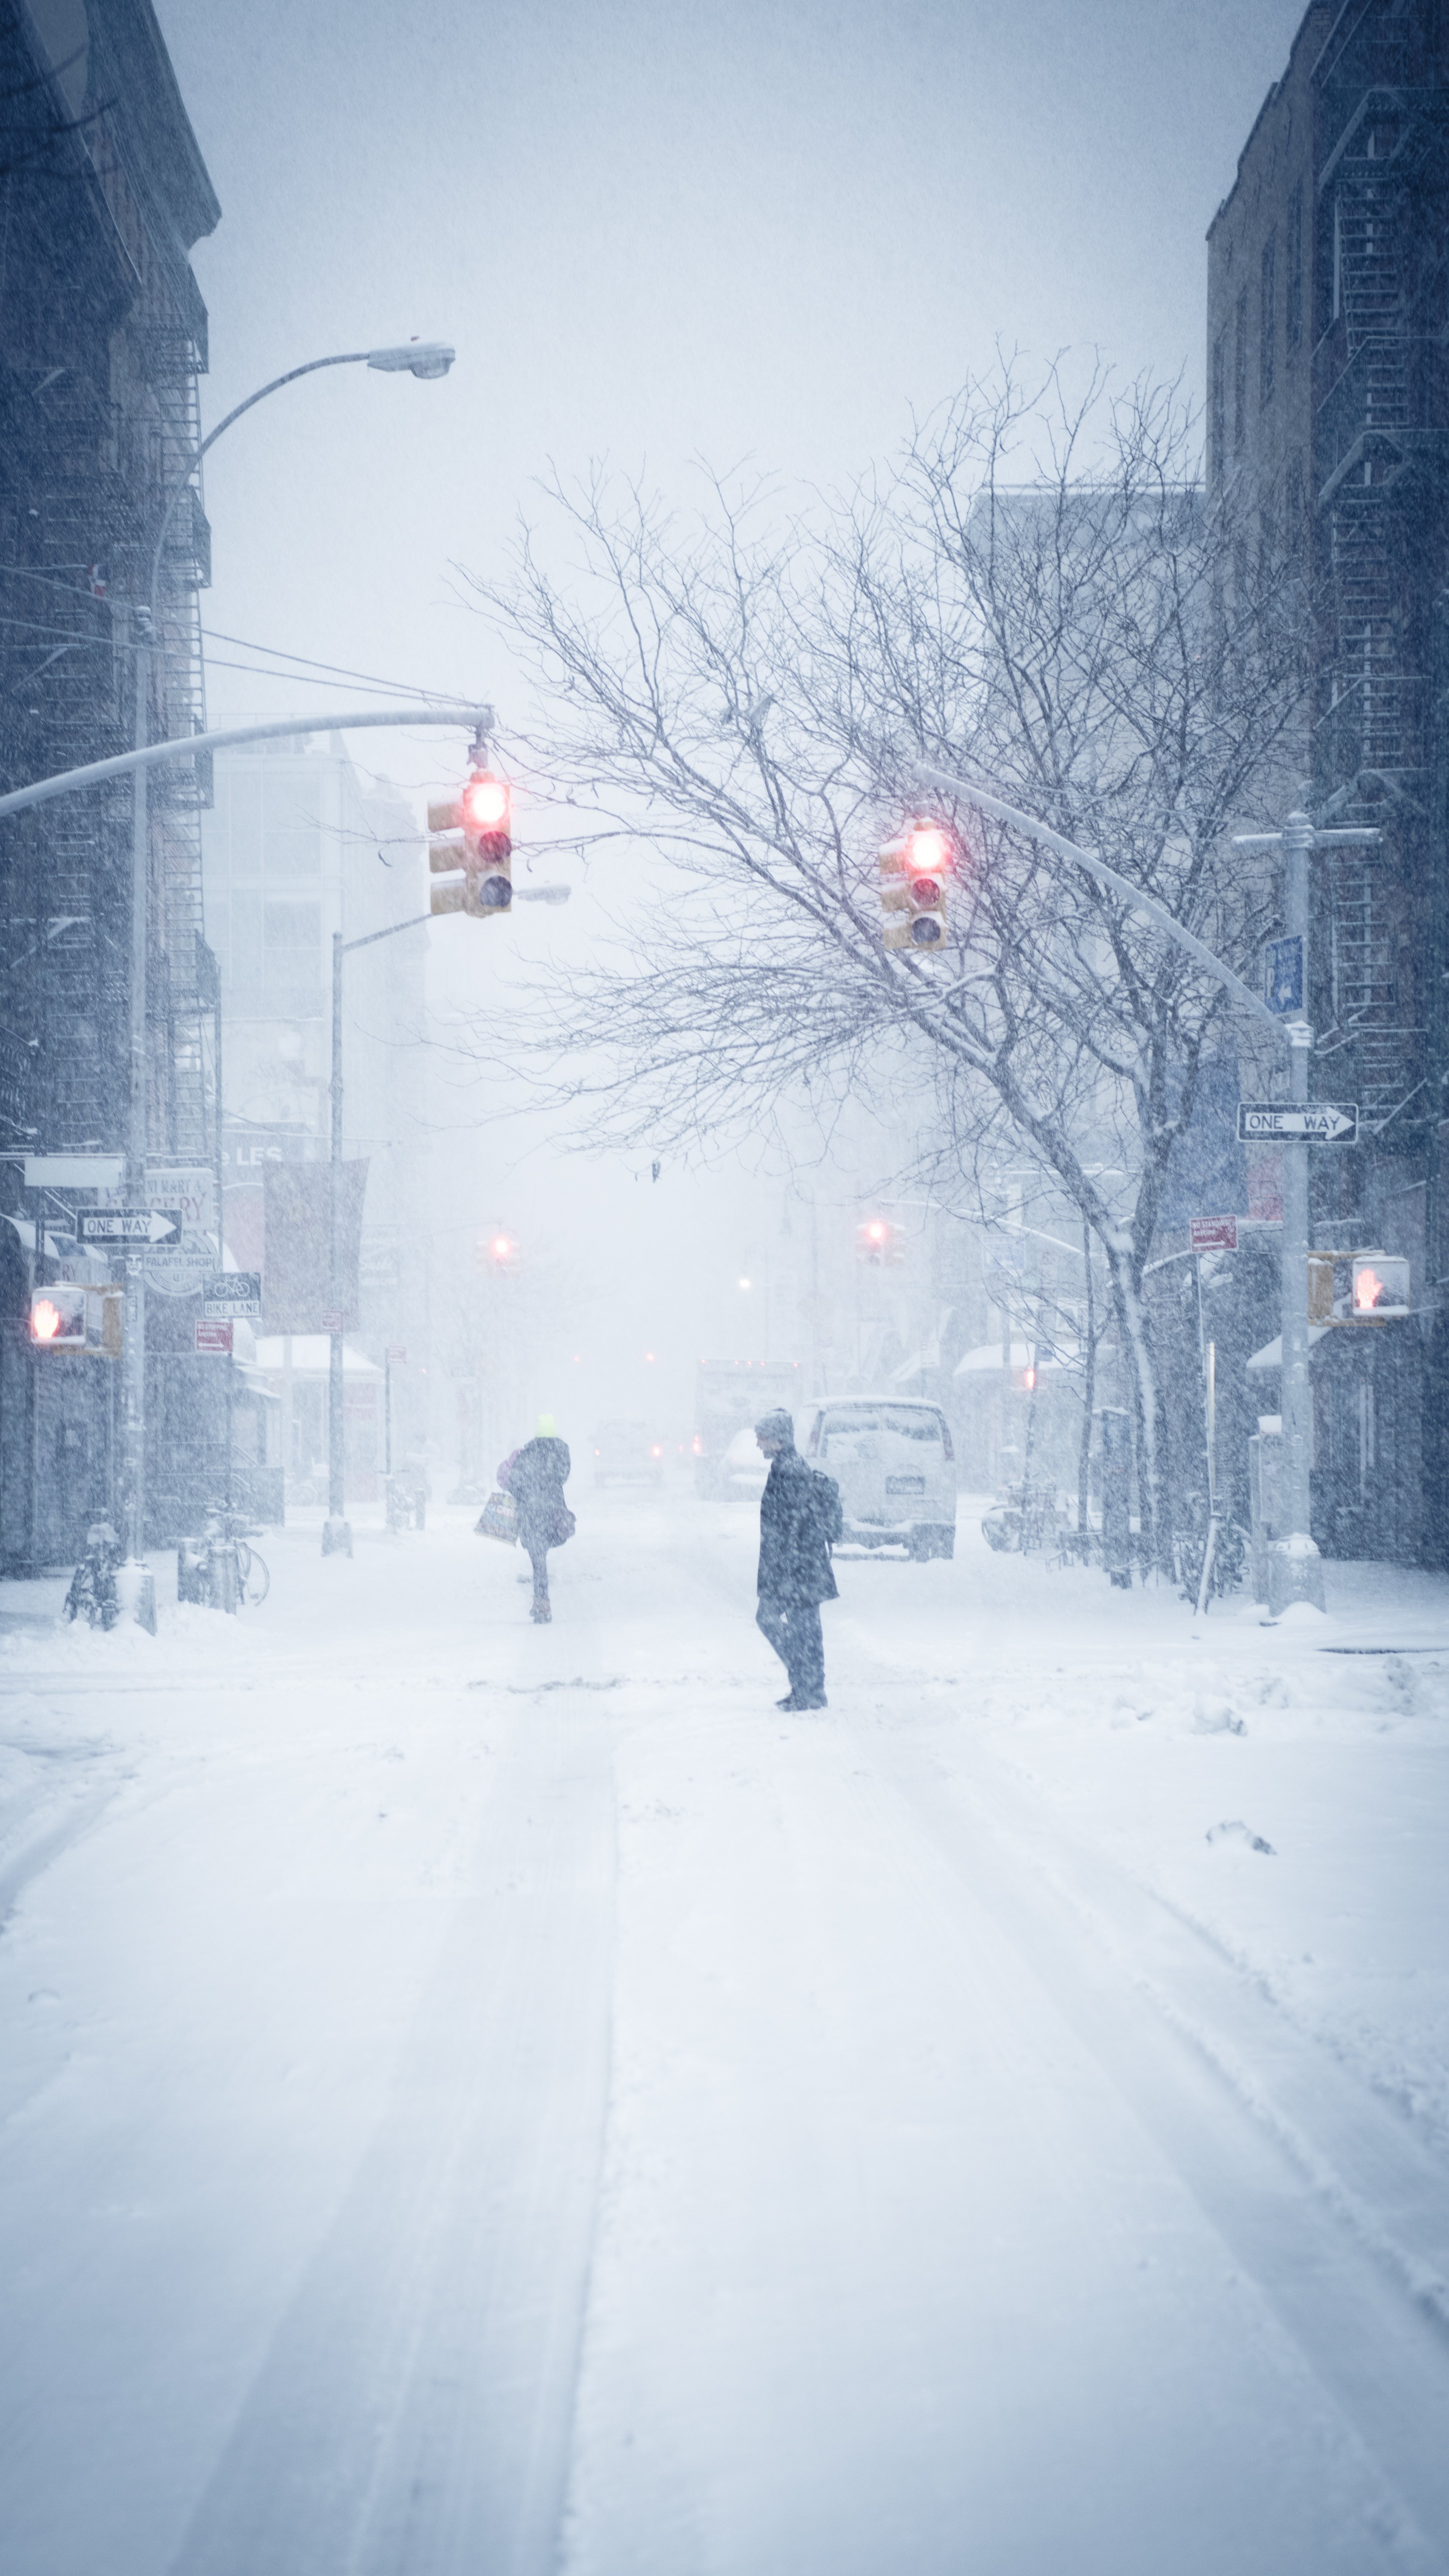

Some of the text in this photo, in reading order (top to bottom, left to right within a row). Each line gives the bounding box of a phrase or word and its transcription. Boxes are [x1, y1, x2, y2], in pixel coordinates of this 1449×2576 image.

[1249, 1115, 1340, 1130] ONE WAY
[236, 1147, 282, 1166] LES
[161, 1179, 191, 1193] MART
[87, 1219, 151, 1233] ONE WAY
[146, 1257, 212, 1267] FALAFEL SHOP
[206, 1303, 258, 1314] BIKE LANE
